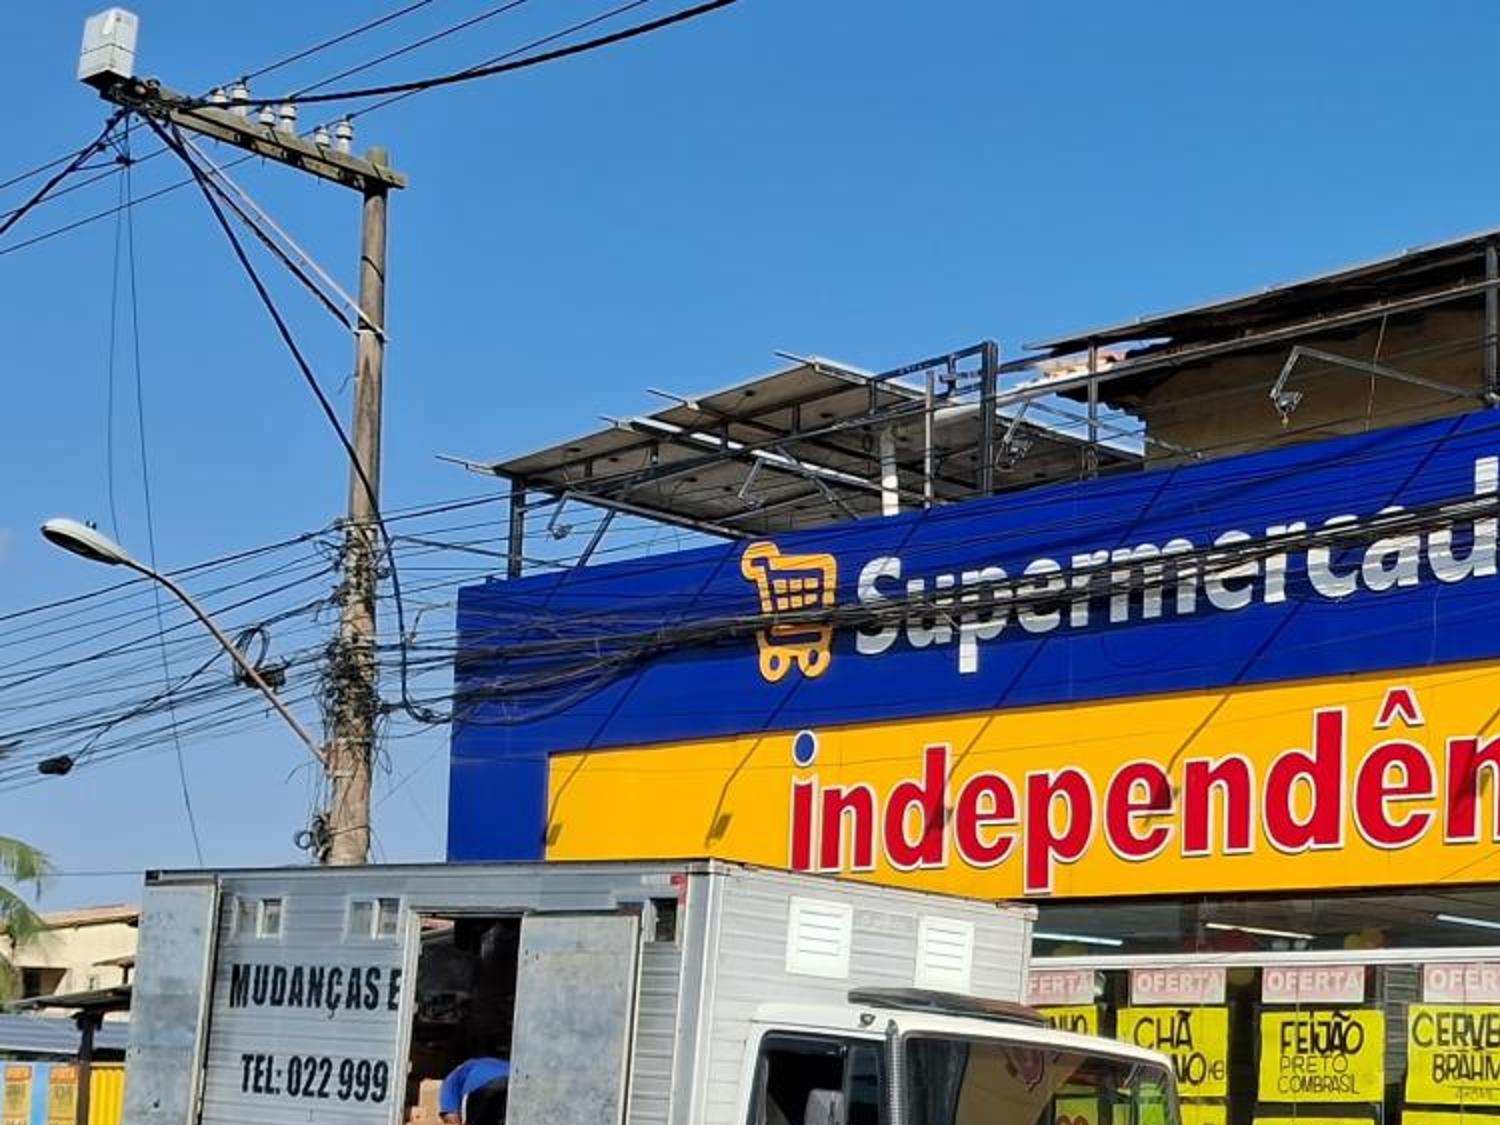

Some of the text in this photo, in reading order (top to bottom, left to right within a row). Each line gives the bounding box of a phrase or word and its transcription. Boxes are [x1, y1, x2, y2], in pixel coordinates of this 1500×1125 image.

[230, 963, 381, 1020] MUDANÇAS
[1136, 970, 1225, 995] OFERTA
[1266, 970, 1361, 993] OFERTA
[1133, 1009, 1193, 1050] CHÃ
[1280, 1009, 1365, 1056] FEIJÃO
[241, 1053, 389, 1103] TEL: 022 999
[1279, 1054, 1349, 1075] PRETO
